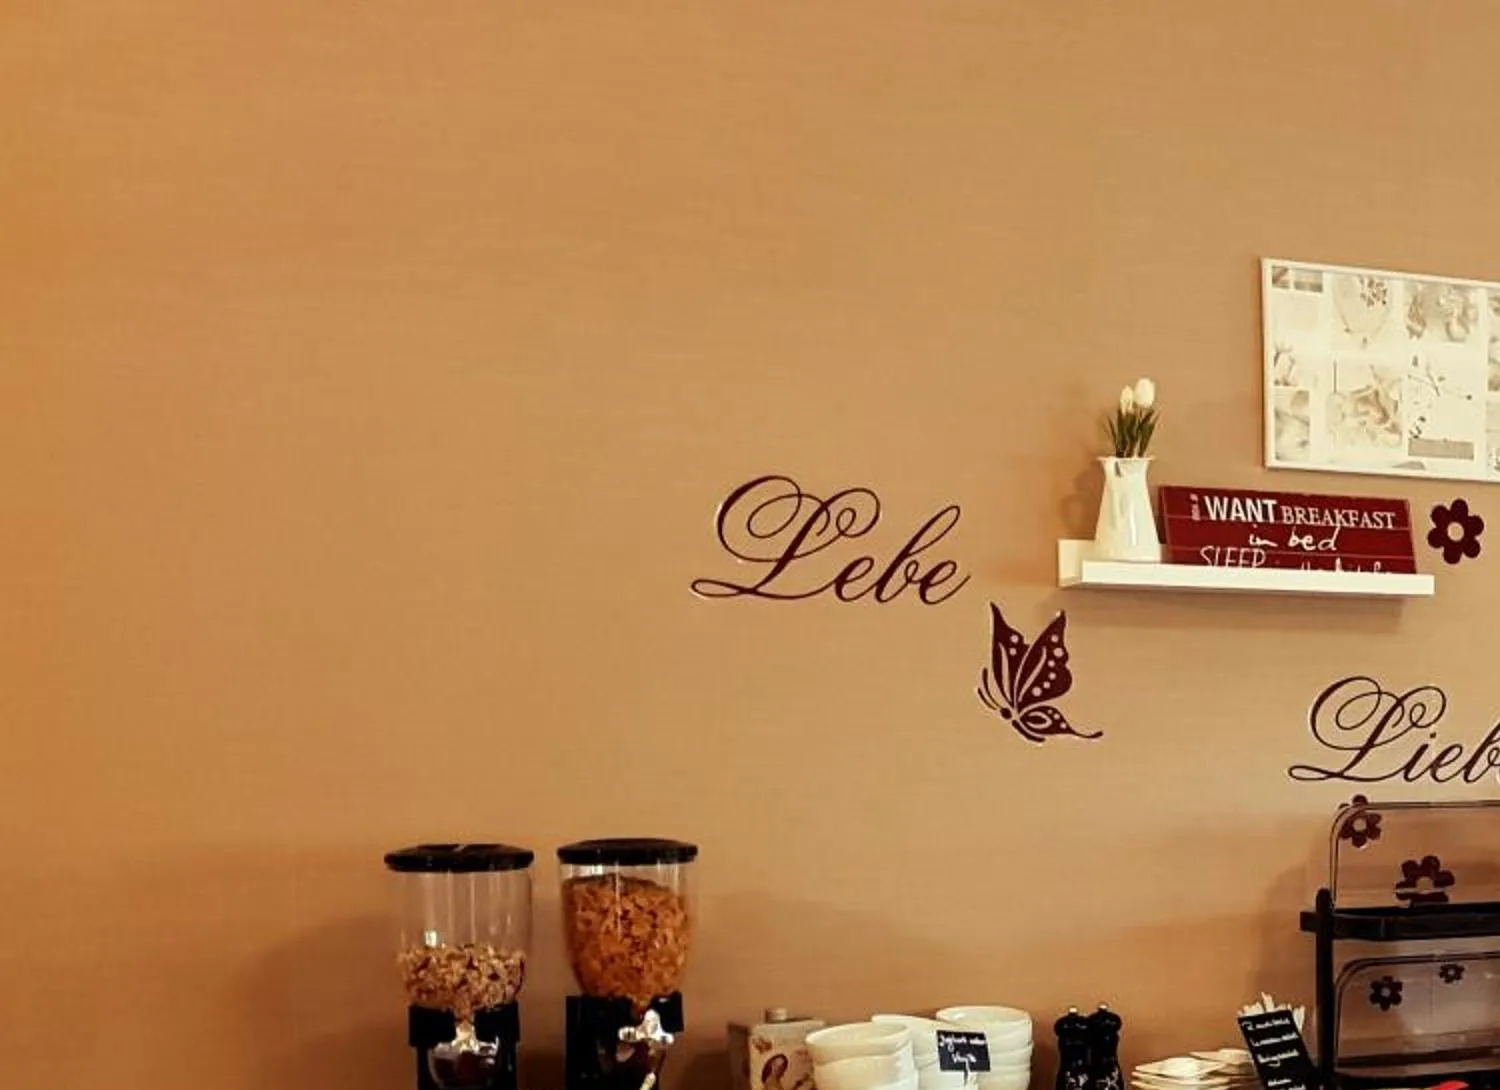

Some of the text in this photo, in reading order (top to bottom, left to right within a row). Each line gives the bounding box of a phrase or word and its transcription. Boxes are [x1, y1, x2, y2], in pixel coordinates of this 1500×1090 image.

[1203, 494, 1278, 523] WANT
[1280, 505, 1396, 529] BREAKFAST
[691, 475, 971, 605] Lebe
[1248, 523, 1341, 551] in bed
